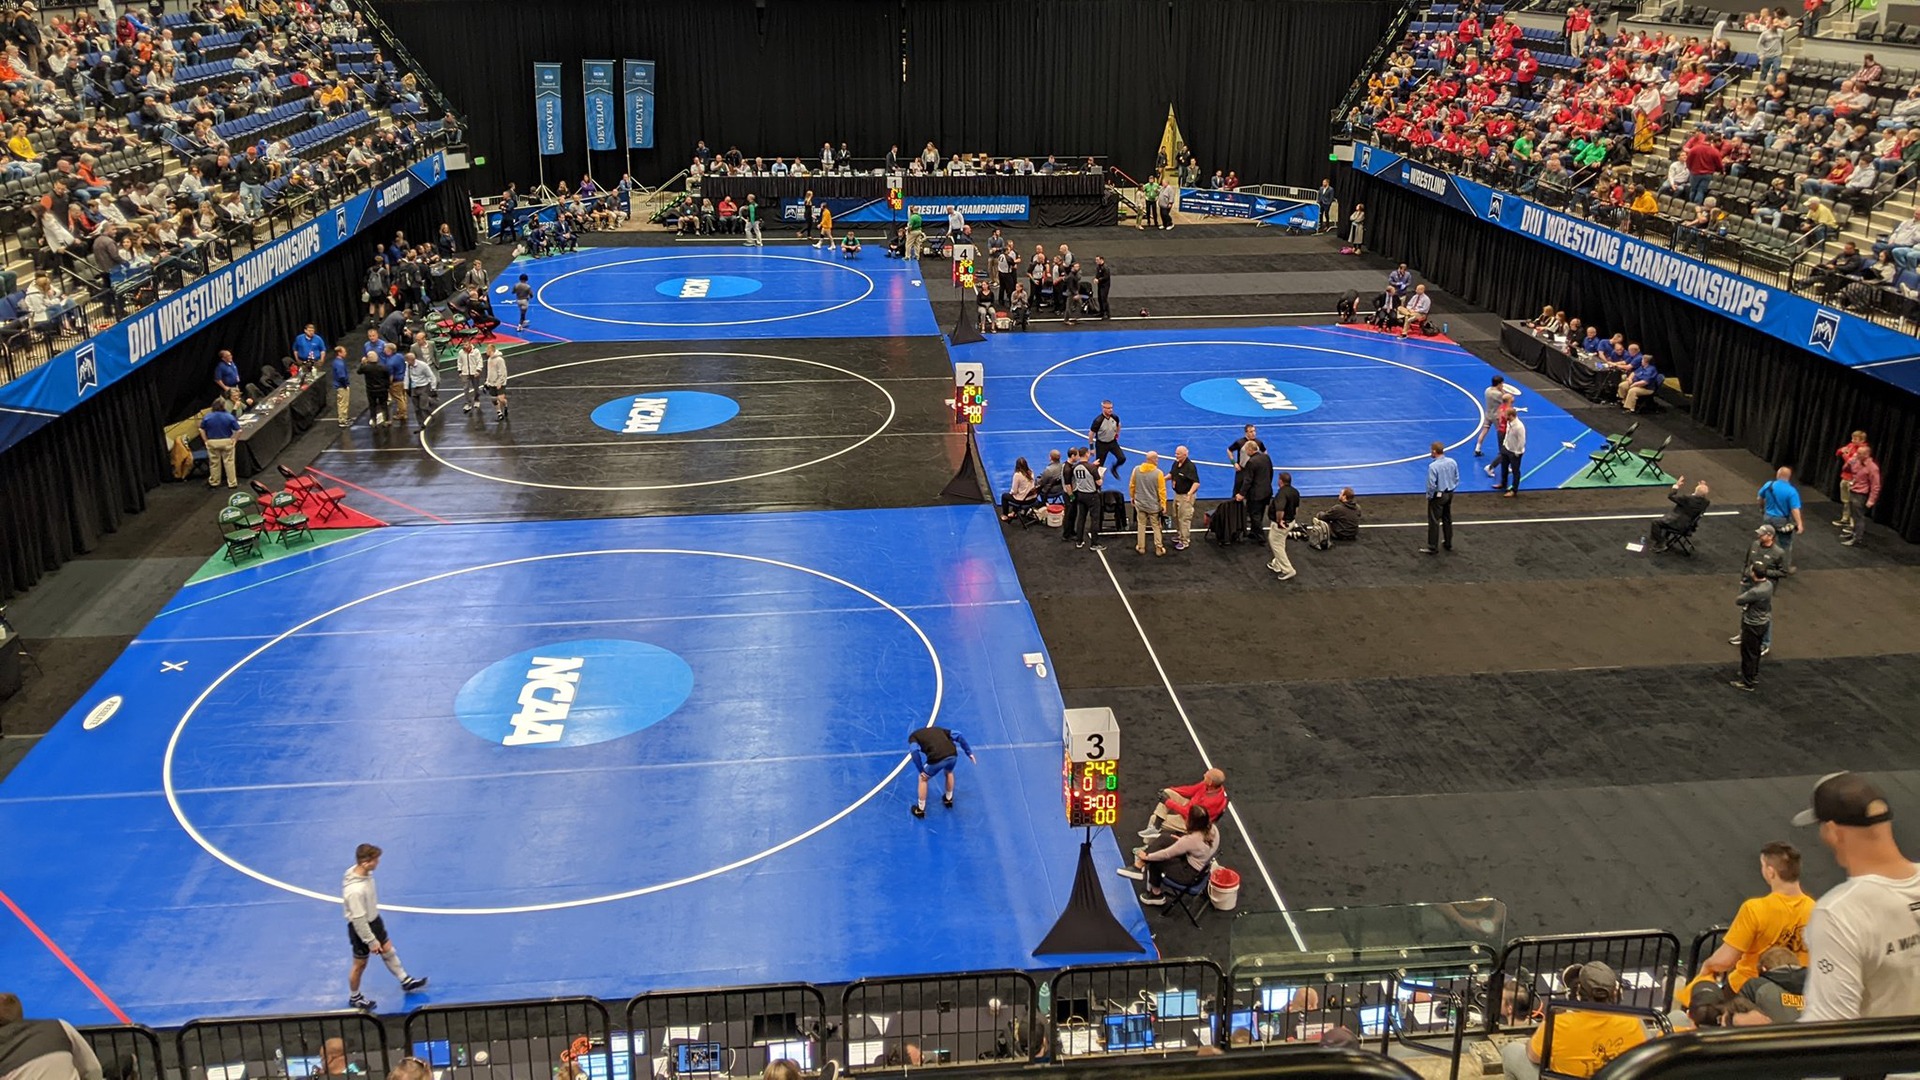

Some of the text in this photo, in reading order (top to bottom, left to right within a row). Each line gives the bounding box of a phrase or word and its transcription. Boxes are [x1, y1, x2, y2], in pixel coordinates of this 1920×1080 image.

[546, 100, 555, 150] DISCOVER
[596, 98, 605, 144] DEVELOP
[635, 95, 643, 144] DEDICATE
[1409, 167, 1447, 196] WRESTLING
[908, 204, 1026, 214] RESTLIN CHAMPIONSHIPS
[960, 249, 968, 259] 4
[959, 266, 974, 274] 0 0
[1520, 204, 1769, 324] DIII WRESTLING CHAMPIONSHIPS
[127, 223, 321, 365] DIII WRESTLING CHAMPIONSHIPS
[679, 279, 710, 298] NCAA
[965, 371, 975, 385] 2
[963, 386, 982, 396] 261
[963, 394, 983, 404] 0 0
[1236, 378, 1298, 410] NCAA
[621, 398, 668, 433] NCAA
[970, 414, 982, 424] 00
[502, 657, 584, 746] NCAA
[1086, 733, 1104, 760] 3
[1084, 760, 1116, 777] 242
[1083, 775, 1117, 792] 0 0
[1083, 794, 1116, 811] 3:00
[1095, 809, 1116, 825] 00
[1886, 942, 1895, 955] A
